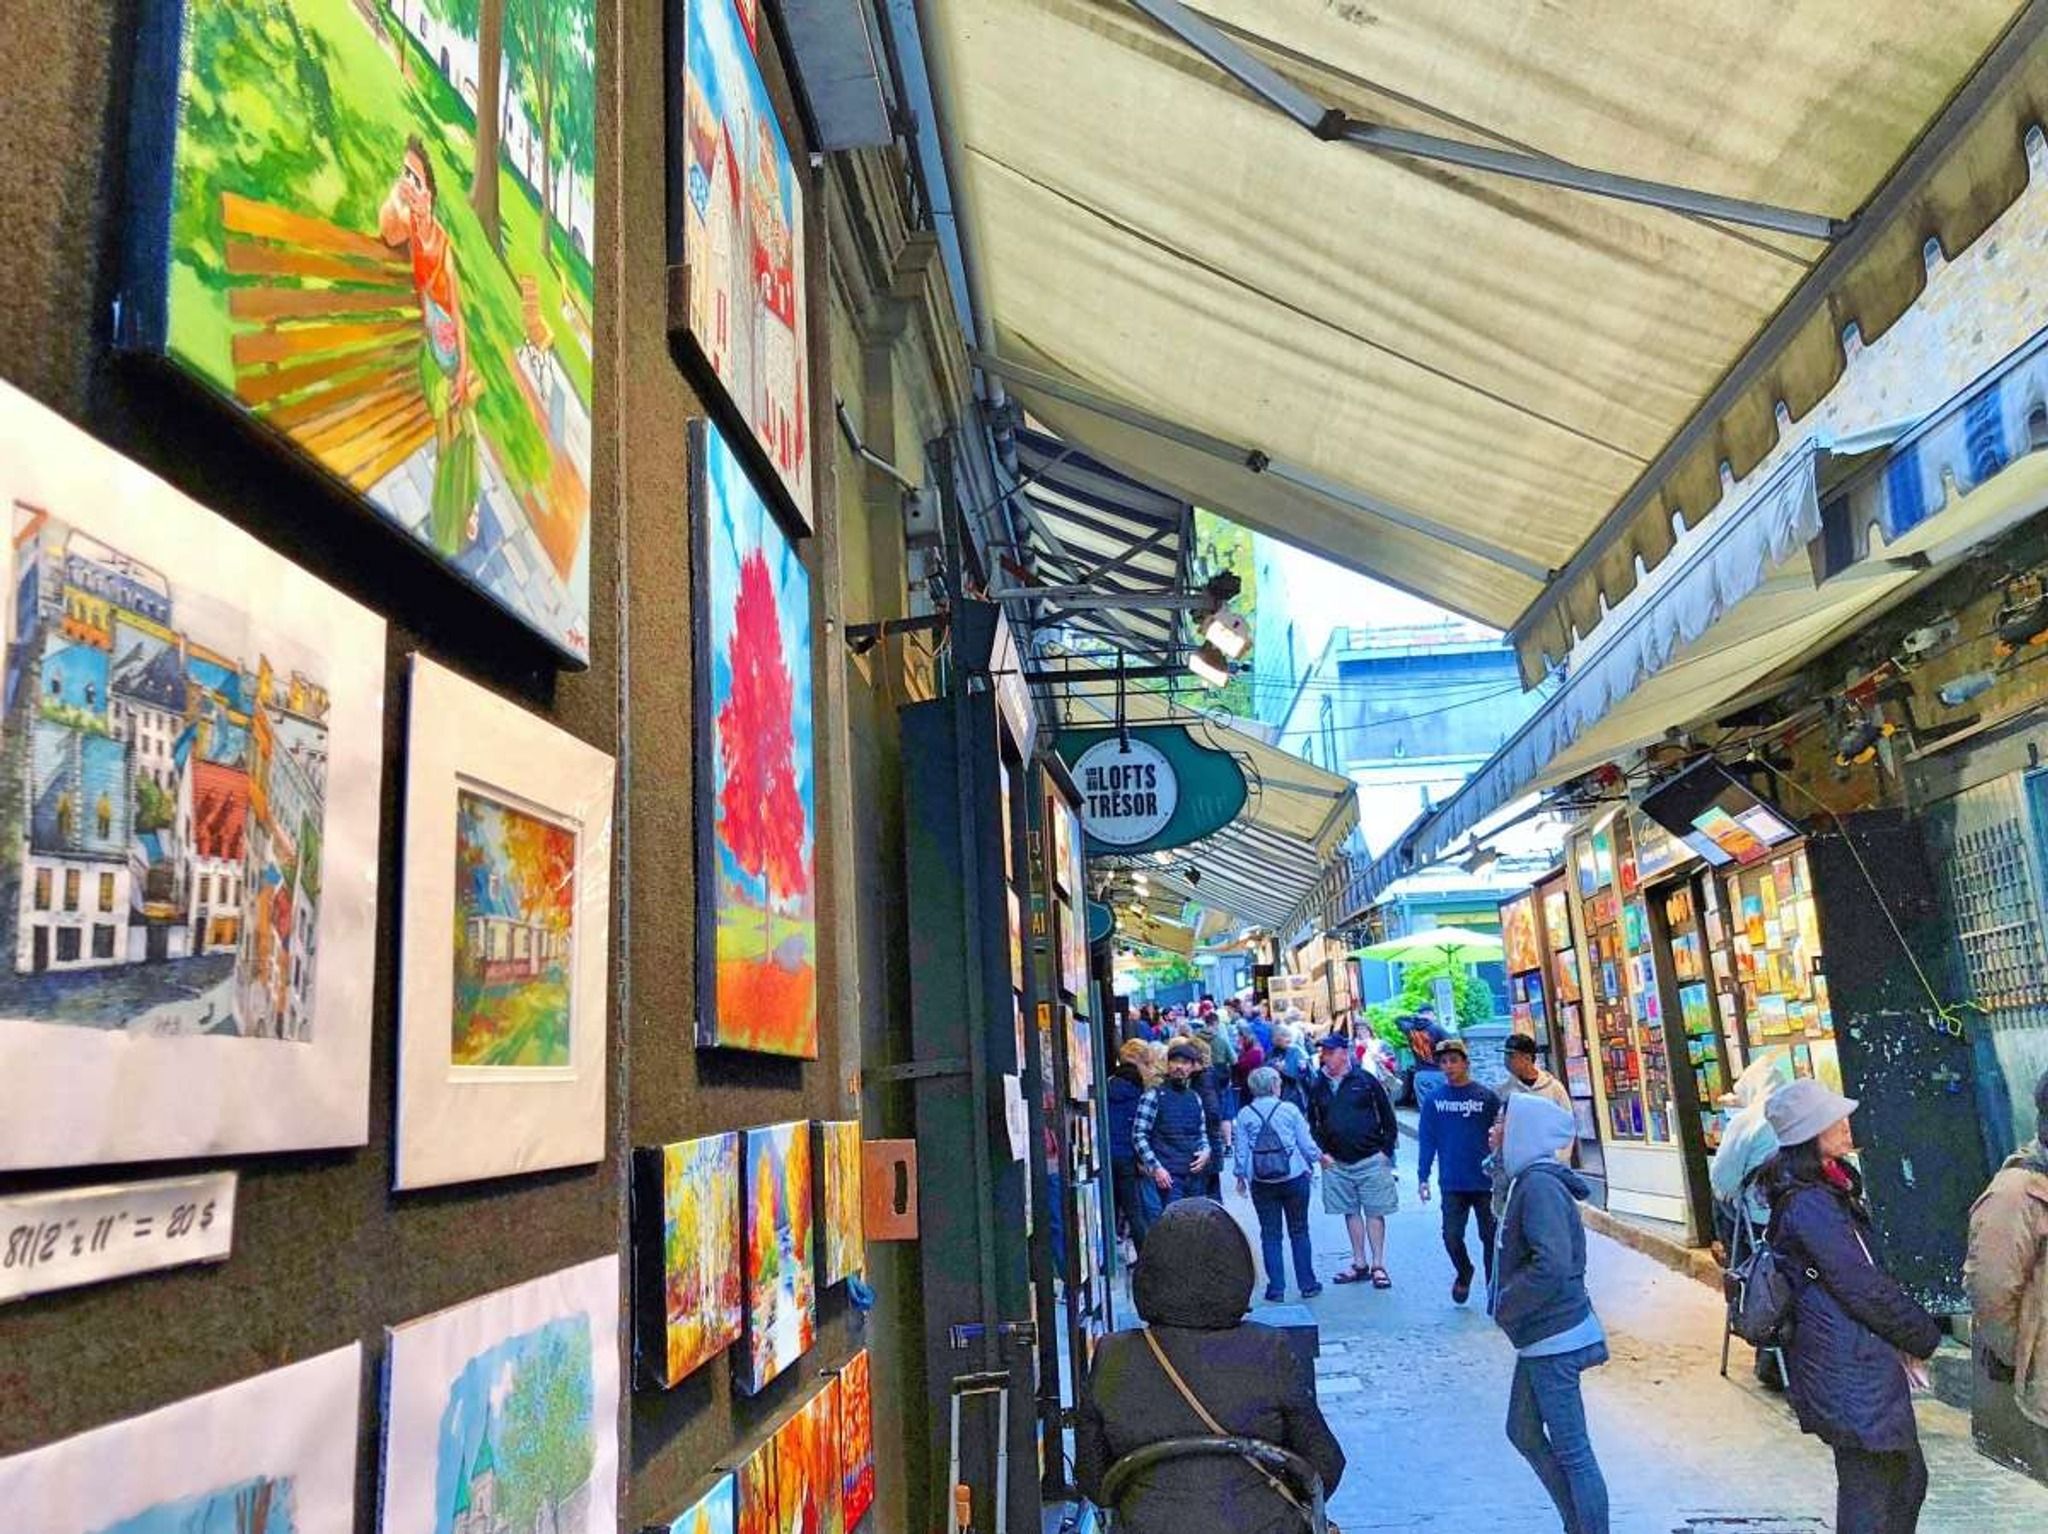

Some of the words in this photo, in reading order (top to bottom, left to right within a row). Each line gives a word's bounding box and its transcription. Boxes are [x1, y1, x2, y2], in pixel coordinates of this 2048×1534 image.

[1098, 764, 1157, 791] LOFTS
[1087, 791, 1158, 818] TRÉSOR
[1434, 1099, 1484, 1118] Wrangler
